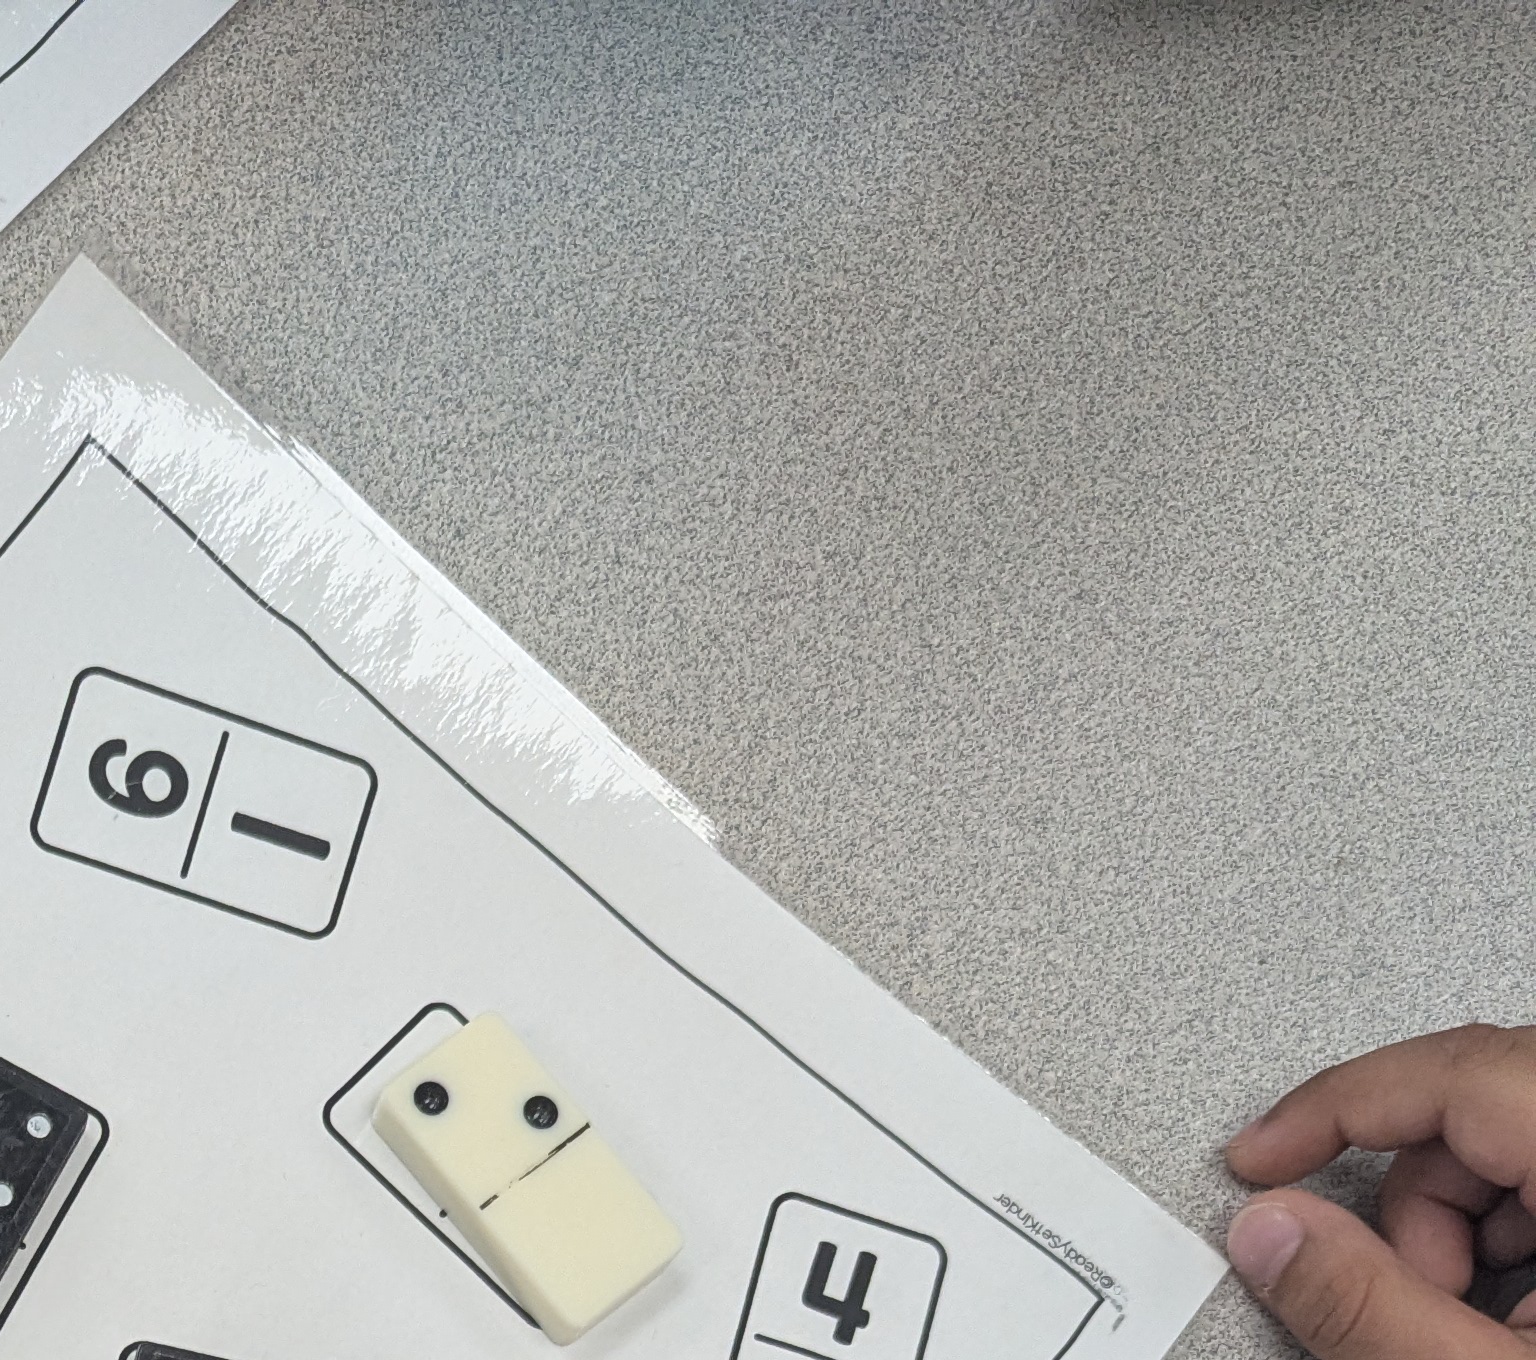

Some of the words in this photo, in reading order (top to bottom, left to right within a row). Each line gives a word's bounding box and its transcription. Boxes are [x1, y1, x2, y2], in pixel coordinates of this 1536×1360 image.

[88, 738, 189, 817] 6
[230, 811, 331, 860] 1
[802, 1241, 878, 1345] 4
